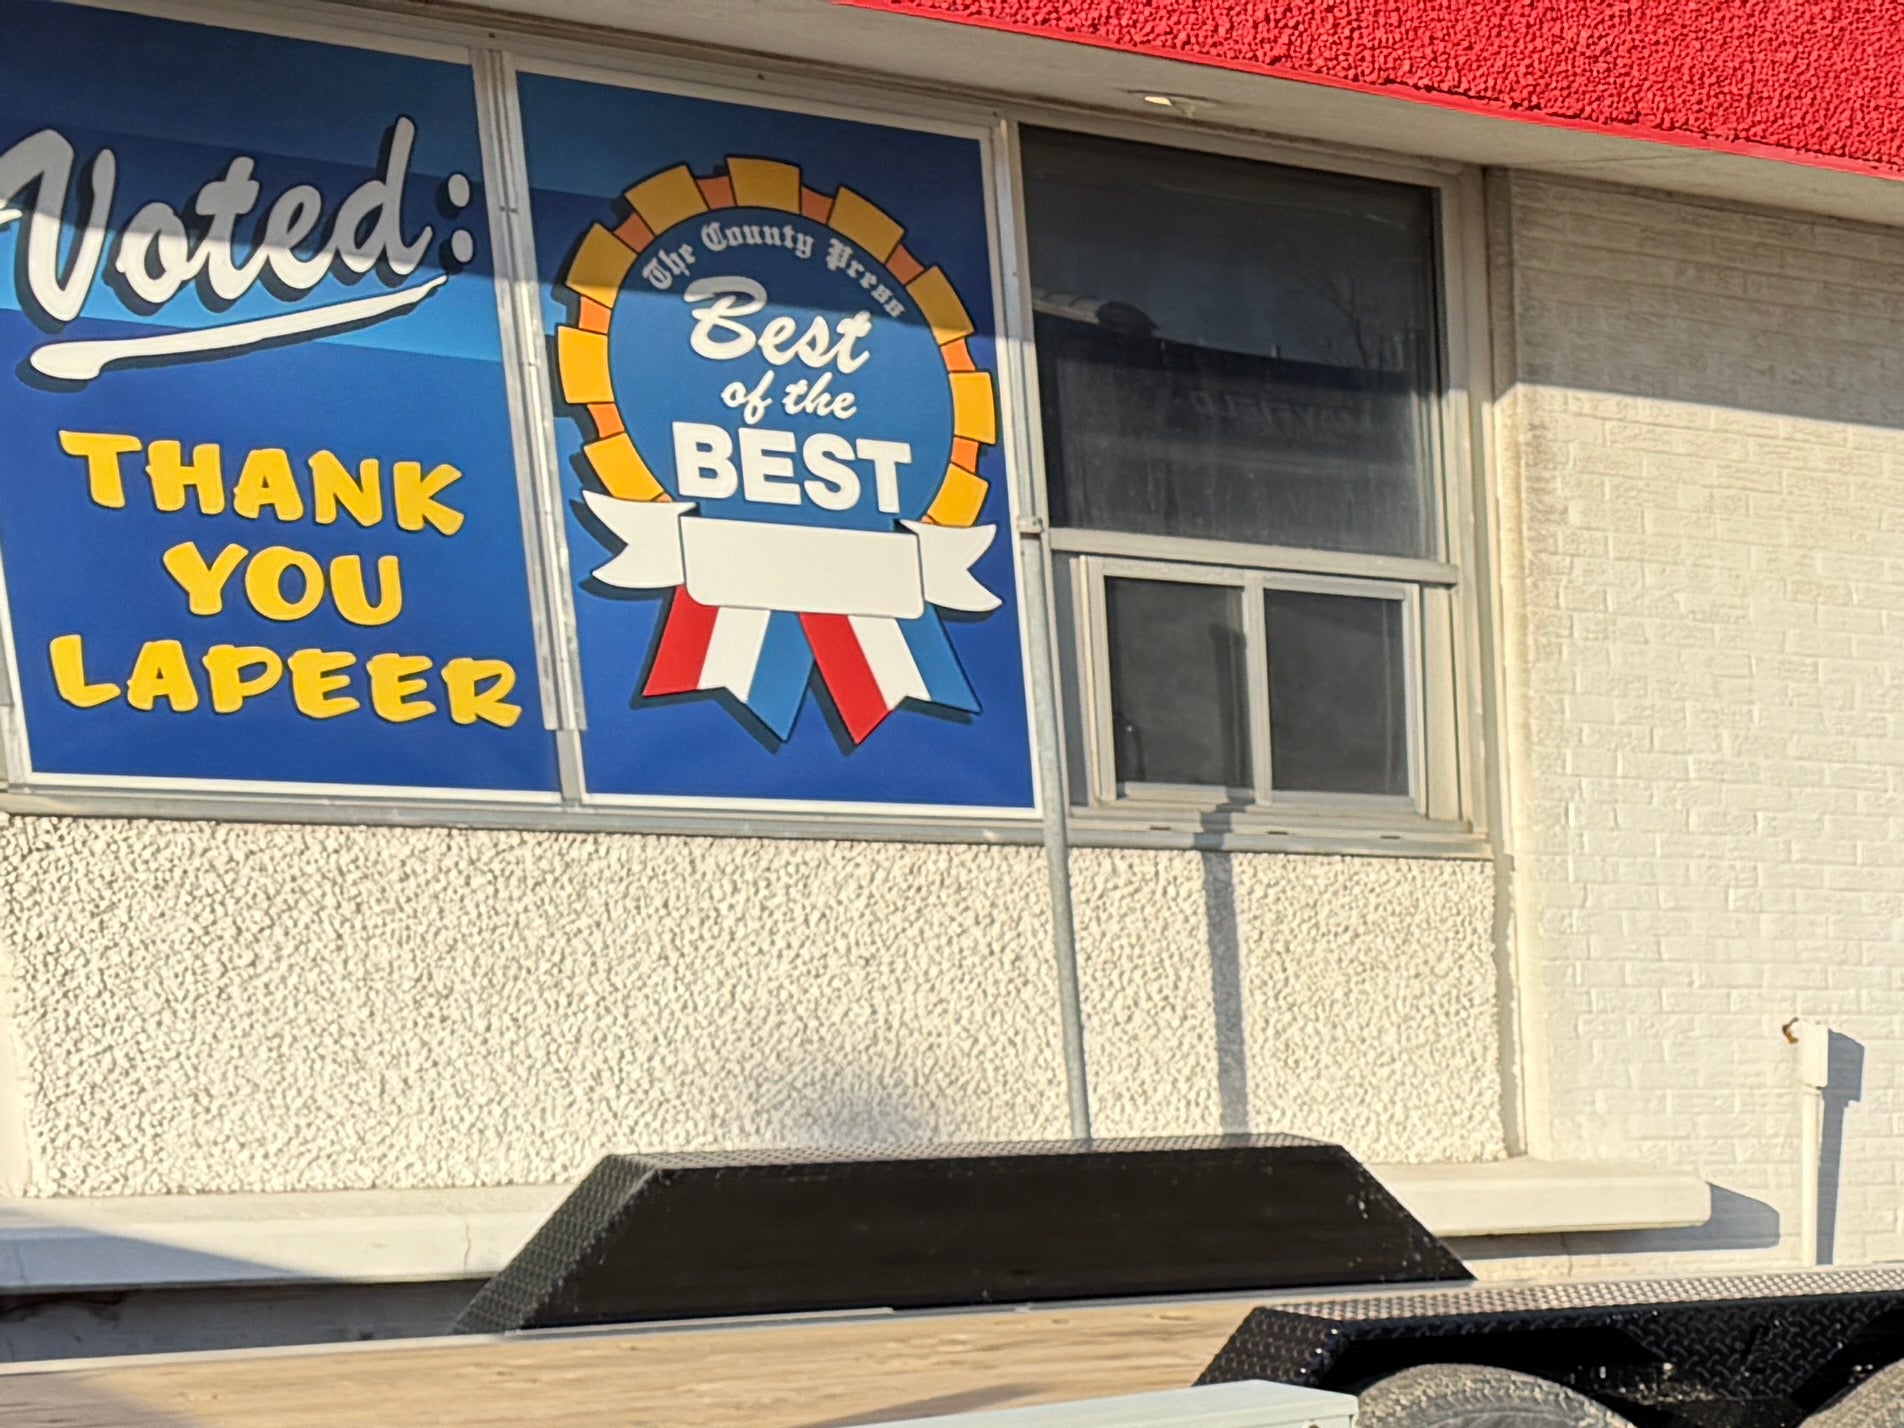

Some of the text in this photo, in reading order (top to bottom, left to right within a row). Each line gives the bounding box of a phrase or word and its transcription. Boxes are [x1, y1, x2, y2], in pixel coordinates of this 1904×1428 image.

[0, 115, 475, 322] Voted:
[642, 221, 905, 318] The County Press
[683, 275, 873, 374] Best
[720, 370, 857, 425] of the
[58, 429, 465, 536] THANK
[672, 420, 912, 514] BEST
[163, 541, 403, 626] YOU
[49, 633, 522, 729] LAPEER
